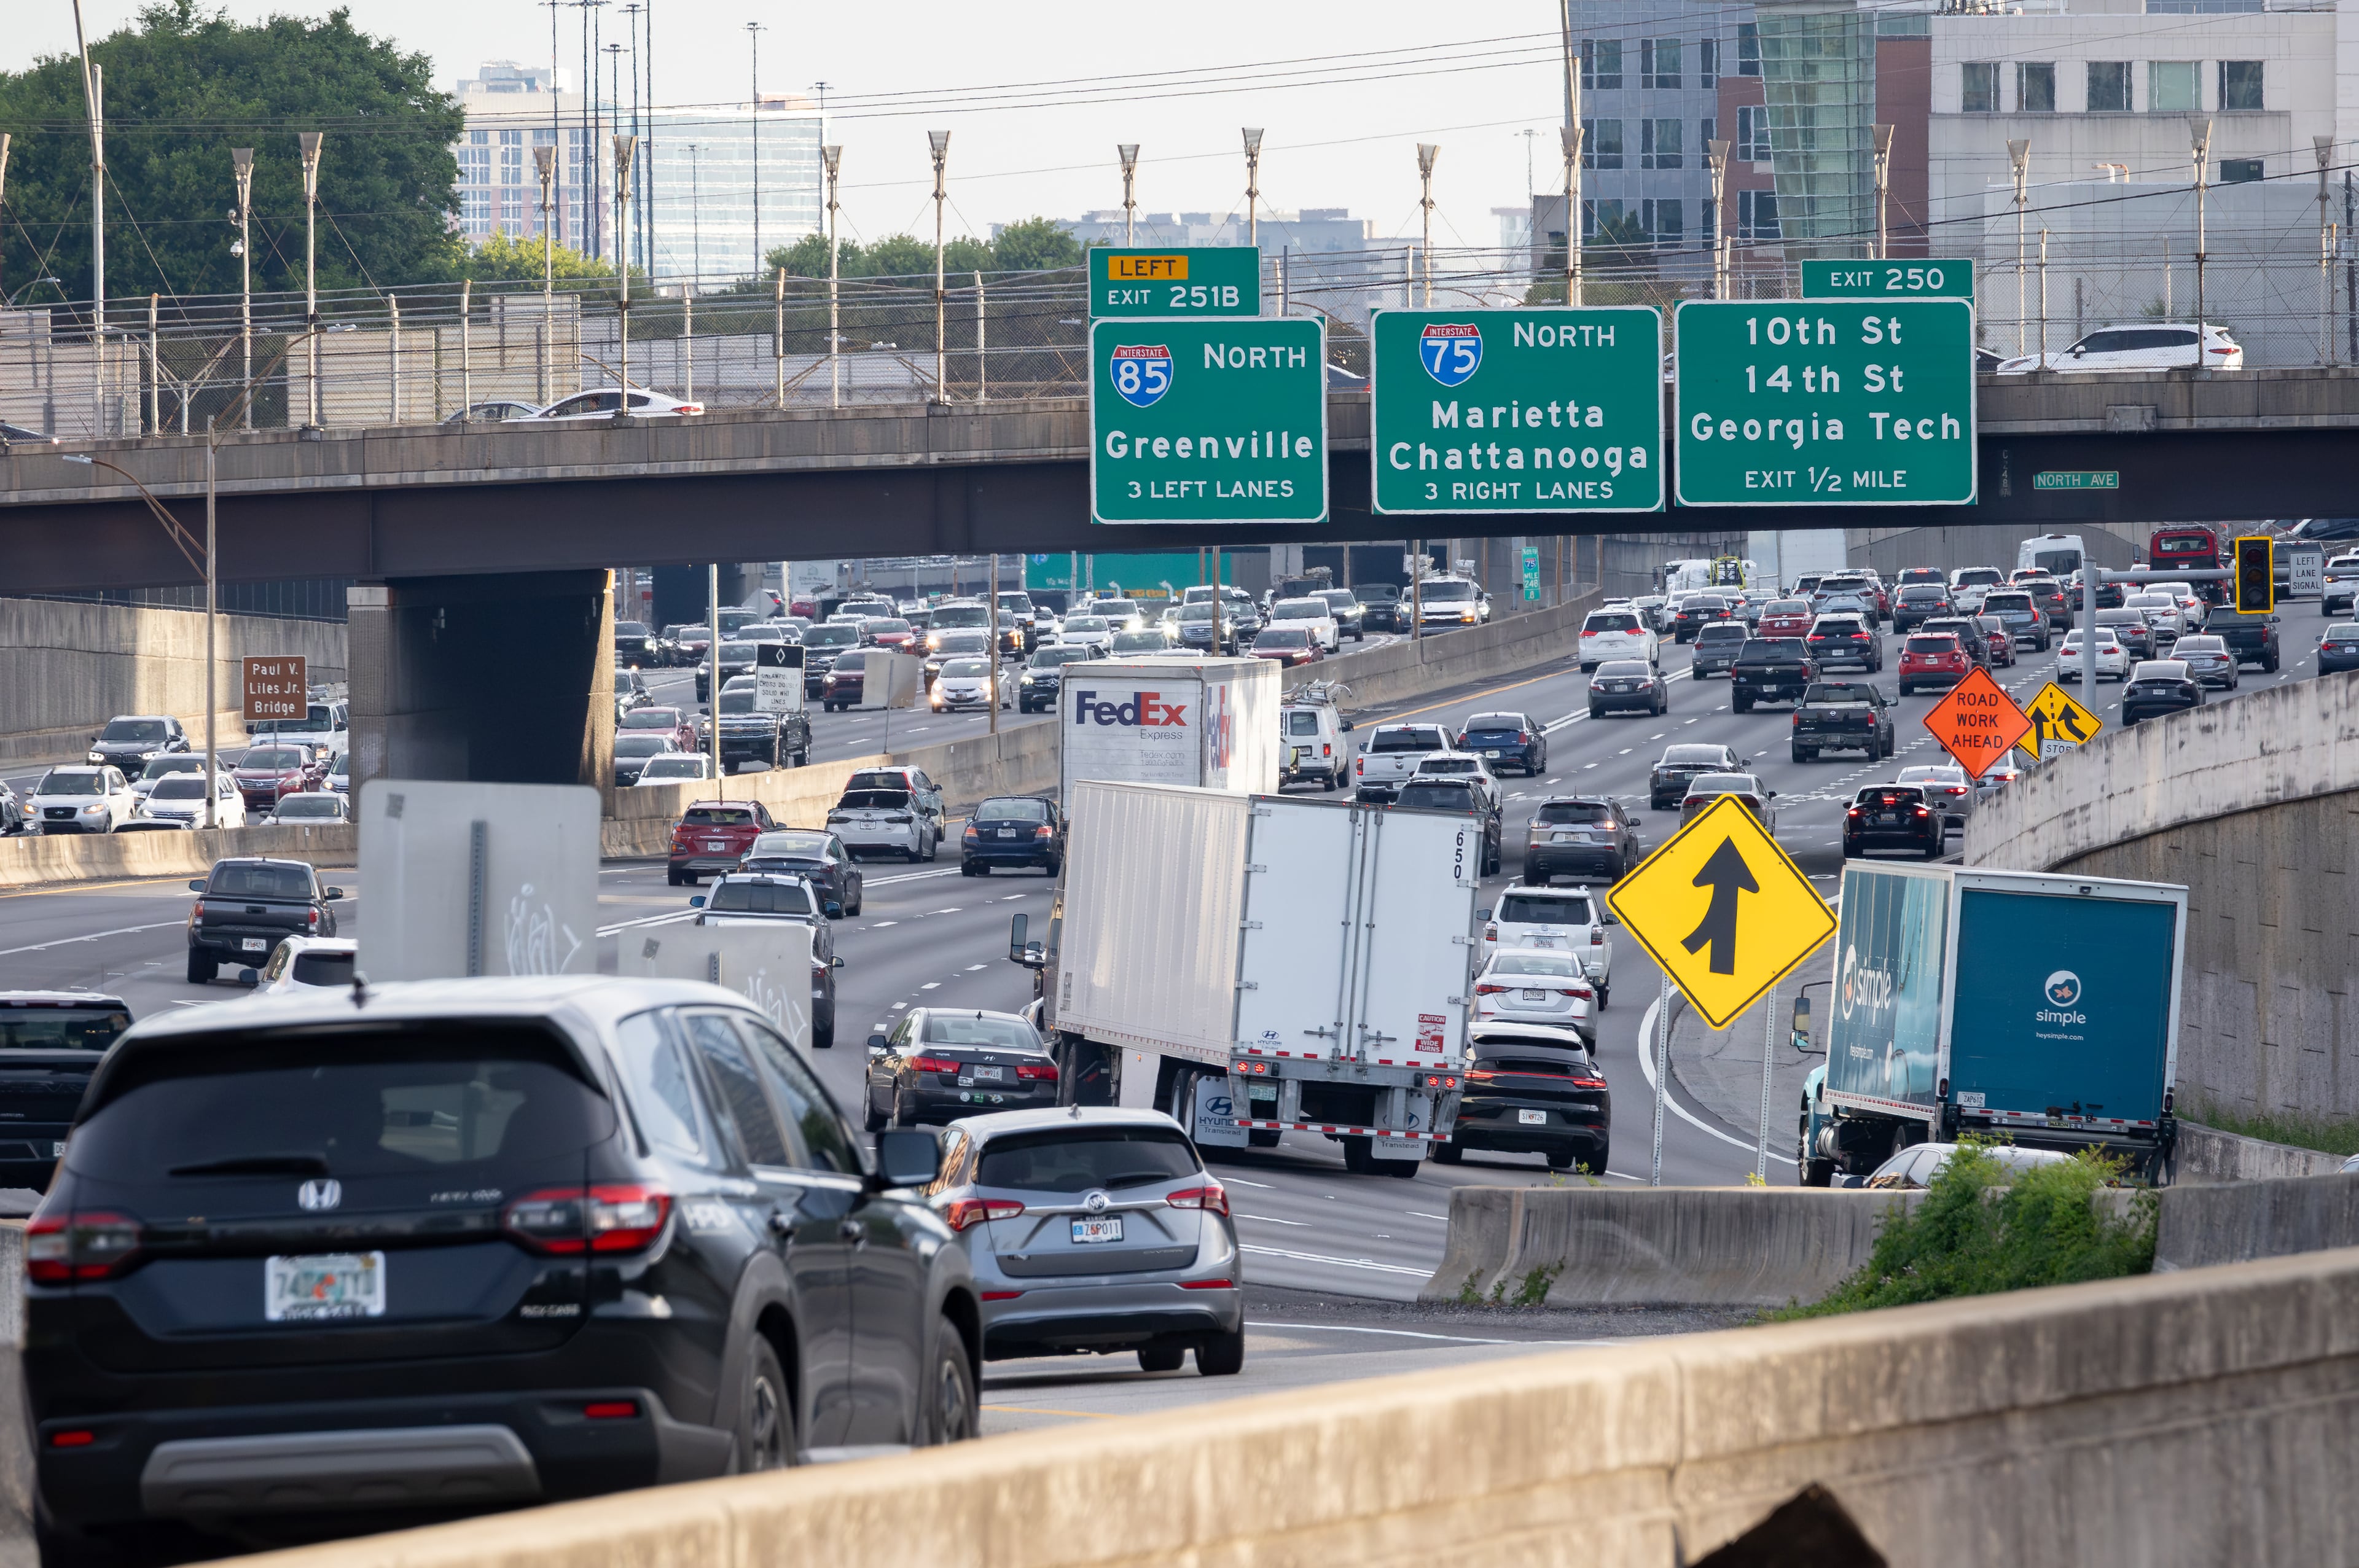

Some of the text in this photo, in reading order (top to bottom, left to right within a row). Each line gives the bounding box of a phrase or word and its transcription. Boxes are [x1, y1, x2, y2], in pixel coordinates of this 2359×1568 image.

[1121, 260, 1176, 276] LEFT
[1831, 268, 1944, 289] EXIT 250
[1108, 286, 1239, 307] EXIT 251B
[1430, 327, 1472, 337] INTERSTATE
[1514, 322, 1614, 347] NORTH
[1747, 316, 1901, 345] 10th St
[1121, 349, 1162, 357] INTERSTATE
[1205, 344, 1305, 369] NORTH
[1426, 340, 1476, 373] 75
[1119, 361, 1167, 394] 85
[1746, 364, 1903, 393] 14th St
[1433, 400, 1603, 429] Marietta
[1692, 412, 1960, 450] Georgia Tech
[1106, 431, 1313, 459] Greenville
[1390, 442, 1647, 478] Chattanooga
[1746, 471, 1796, 488] EXIT
[1853, 471, 1906, 488] MILE
[2038, 474, 2113, 486] NORTH AVE
[1129, 480, 1294, 498] 3 LEFT LANES
[1425, 482, 1613, 500] 3 RIGHT LANES
[2293, 581, 2320, 590] SIGNAL
[252, 663, 299, 675] Paul V.
[249, 681, 300, 694] Liles Jr.
[1957, 693, 1998, 706] ROAD
[255, 701, 295, 716] Bridge
[1076, 691, 1189, 726] FedEx
[1957, 713, 1998, 727] WORK
[1140, 729, 1183, 742] Express
[1952, 734, 2003, 749] AHEAD
[1856, 956, 1892, 1025] simple
[2036, 1009, 2086, 1026] simple
[2036, 1032, 2084, 1040] heysimple.com
[1964, 1095, 1983, 1104] ZAP612
[1199, 1117, 1234, 1126] HYUN
[1204, 1127, 1241, 1136] Translead
